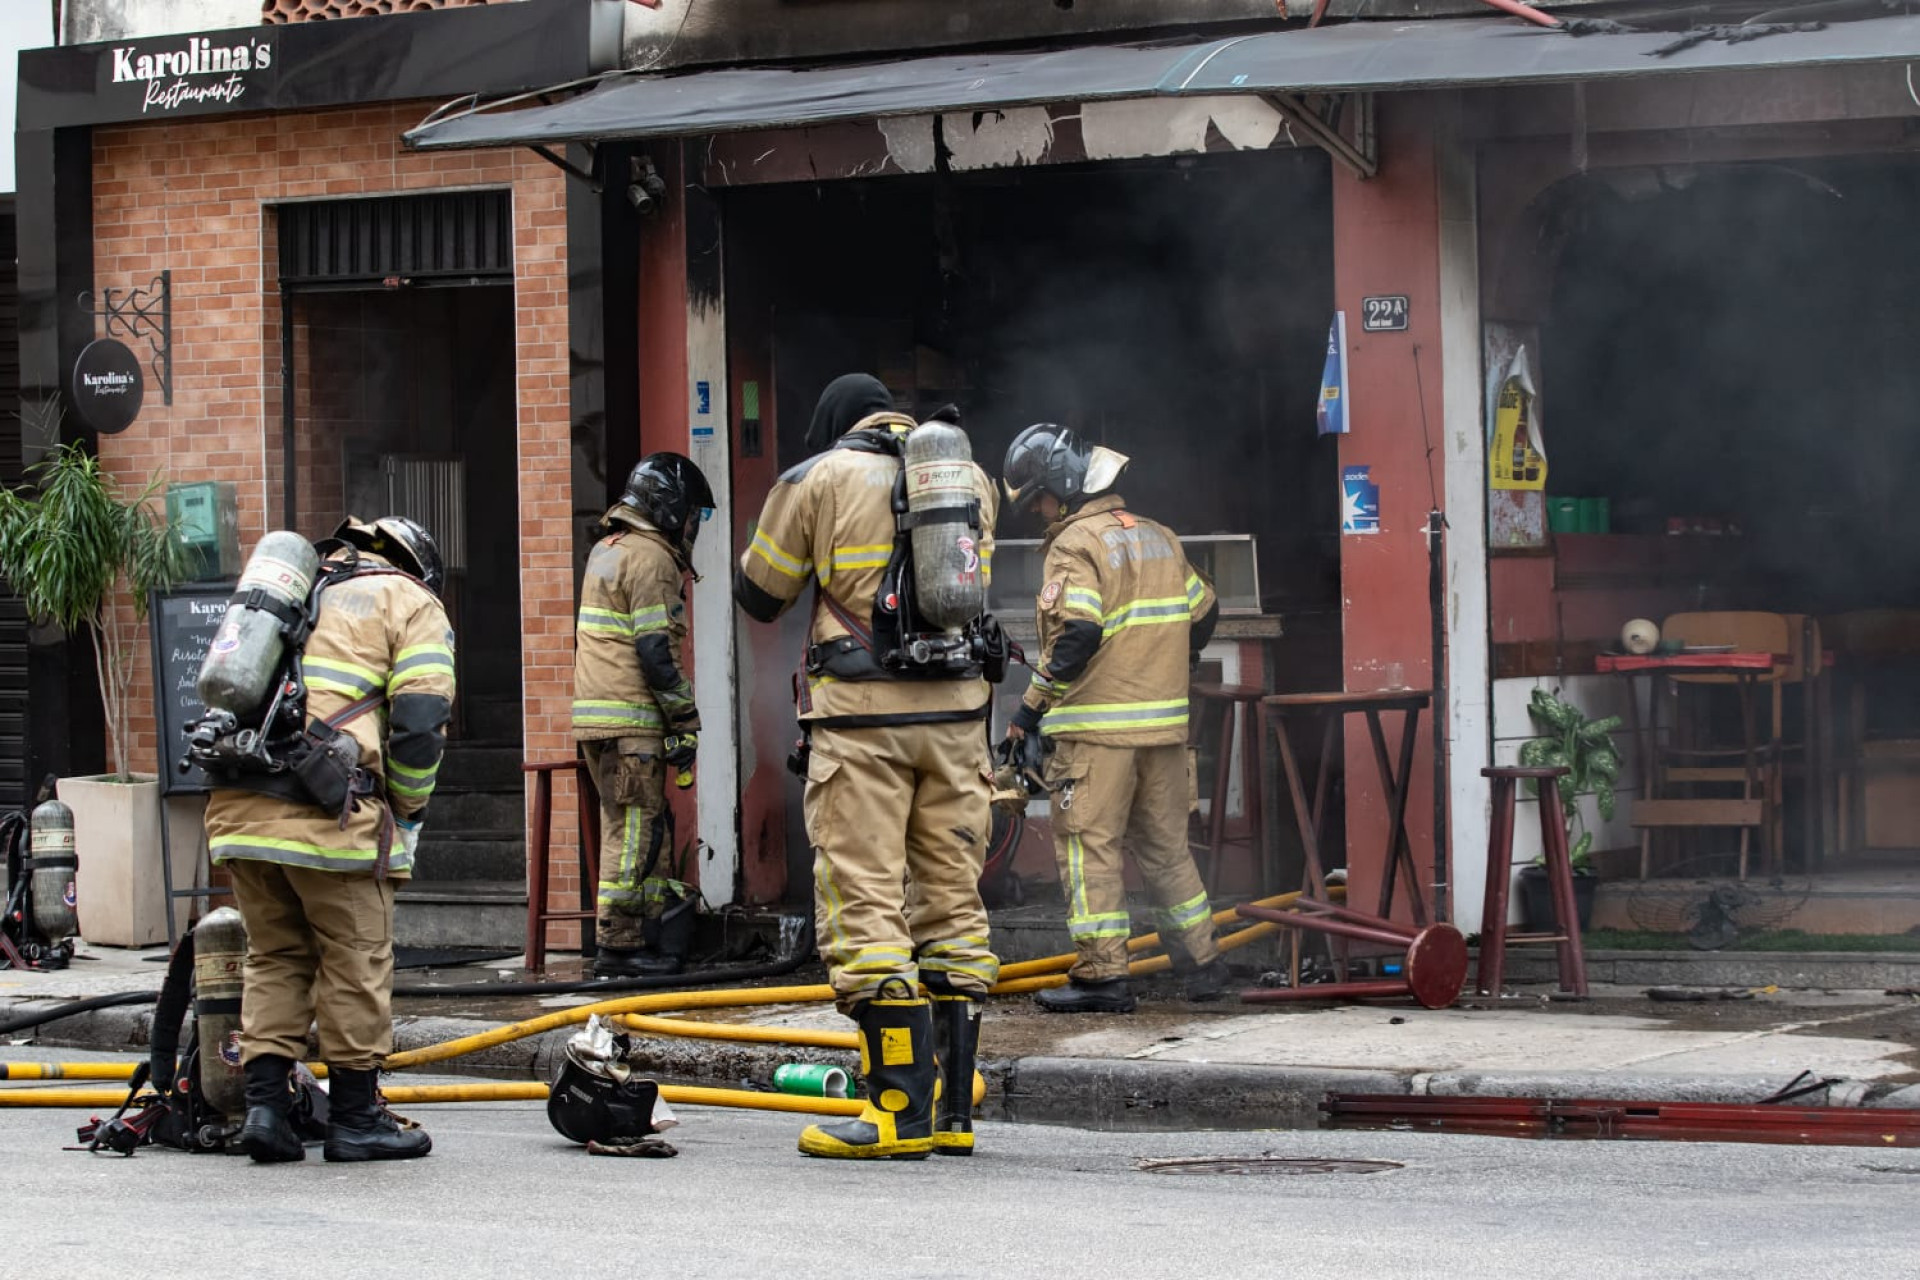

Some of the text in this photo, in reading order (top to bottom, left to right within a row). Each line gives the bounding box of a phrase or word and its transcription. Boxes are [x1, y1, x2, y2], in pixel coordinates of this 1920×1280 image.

[112, 37, 271, 83] Karolina's
[142, 73, 245, 113] Restaurante
[83, 371, 134, 386] Karolina's
[931, 470, 961, 479] SCOTT
